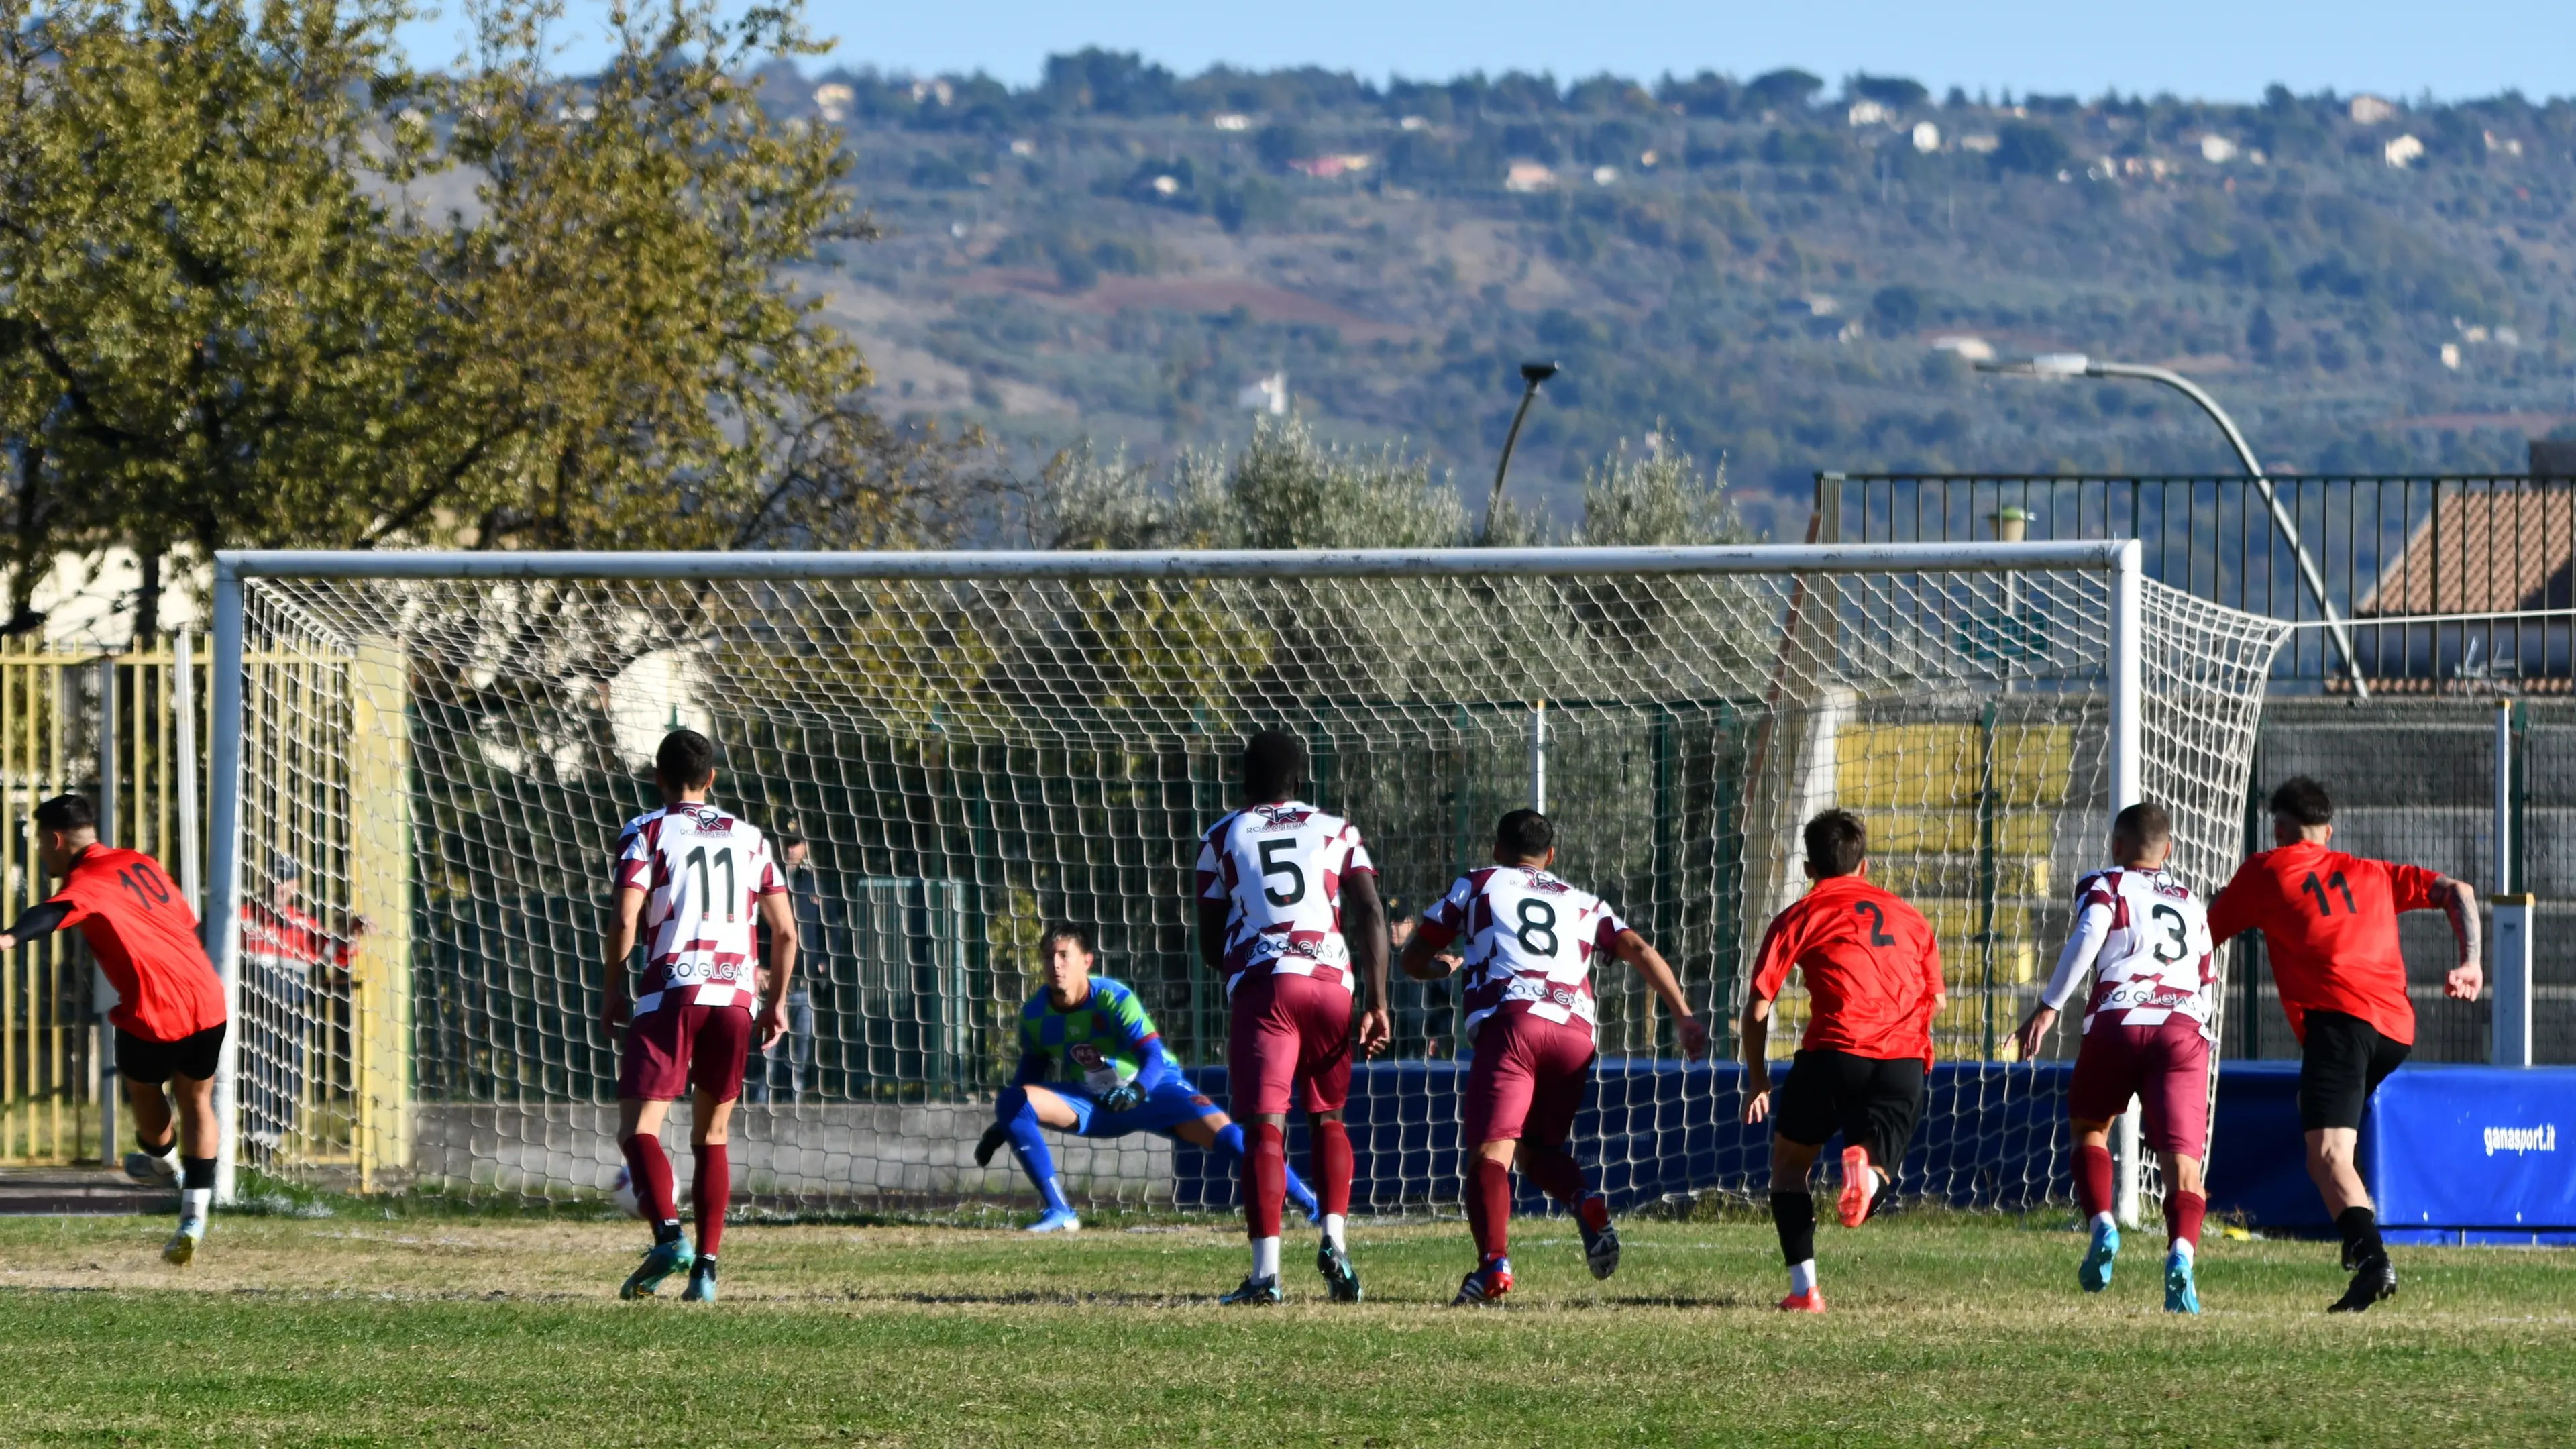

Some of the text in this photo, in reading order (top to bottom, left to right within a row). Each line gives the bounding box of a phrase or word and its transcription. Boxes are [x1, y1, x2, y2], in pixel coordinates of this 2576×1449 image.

[1246, 822, 1309, 834] ROMANERIA
[117, 863, 169, 911] 10
[685, 845, 735, 923] 11
[1257, 837, 1305, 907] 5
[2301, 871, 2357, 917] 11
[1517, 898, 1558, 958] 8
[1855, 900, 1896, 947] 2
[2152, 904, 2188, 967] 3
[661, 962, 749, 982] CO.GI.GAS
[1576, 1155, 1610, 1165] Pollio
[2484, 1122, 2555, 1157] ganasport.it
